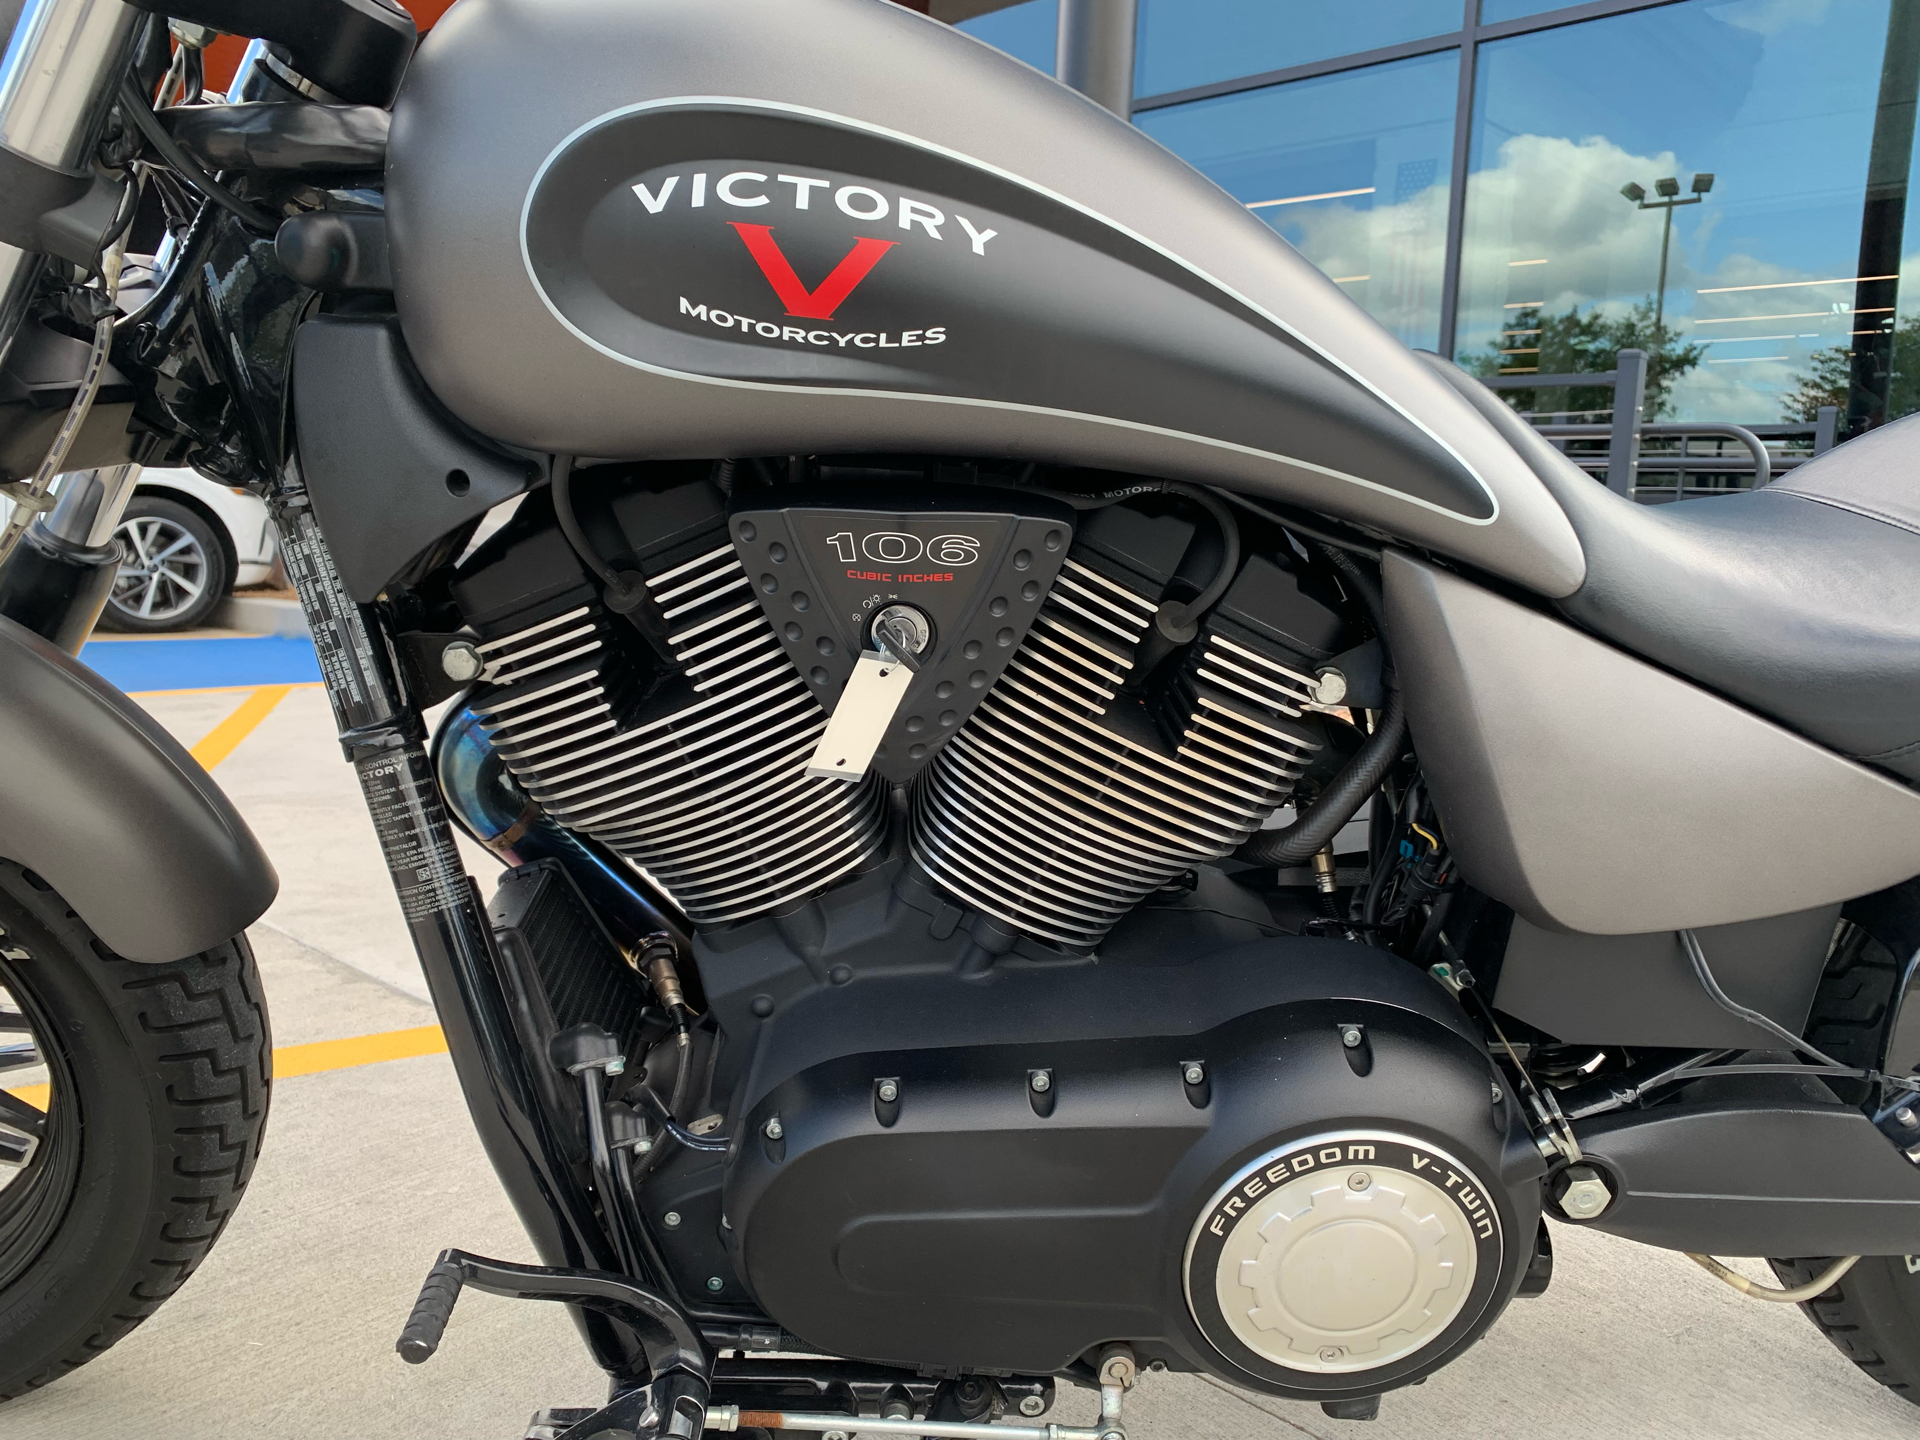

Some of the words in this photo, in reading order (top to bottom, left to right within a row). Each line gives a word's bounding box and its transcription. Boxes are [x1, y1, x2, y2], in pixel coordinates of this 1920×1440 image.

[631, 171, 998, 256] VICTORY
[726, 221, 901, 321] V
[680, 296, 947, 348] MOTORCYCLES
[826, 531, 981, 566] 106
[847, 570, 892, 582] CUBIC
[898, 572, 954, 583] INCHES
[364, 756, 397, 769] CONTROL
[392, 799, 415, 809] FACTORY
[1209, 1145, 1376, 1237] FREEDOM
[1411, 1153, 1494, 1239] V-TWIN
